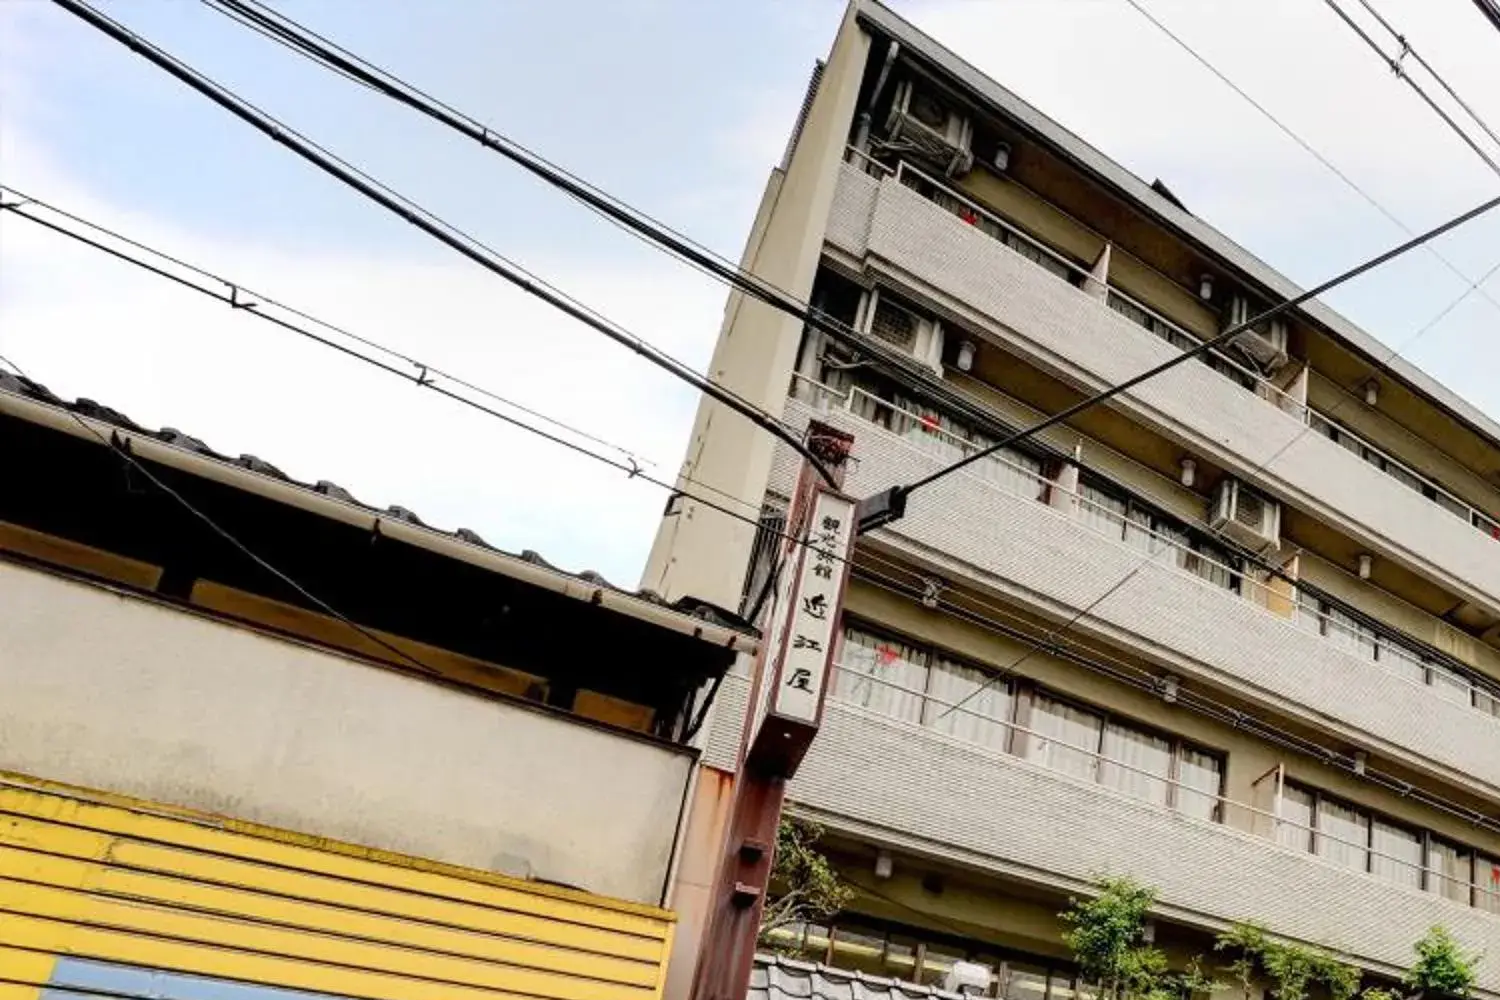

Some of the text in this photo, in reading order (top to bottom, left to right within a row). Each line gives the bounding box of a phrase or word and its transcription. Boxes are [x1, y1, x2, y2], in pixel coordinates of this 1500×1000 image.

[786, 515, 841, 694] 観光旅館 近江屋
